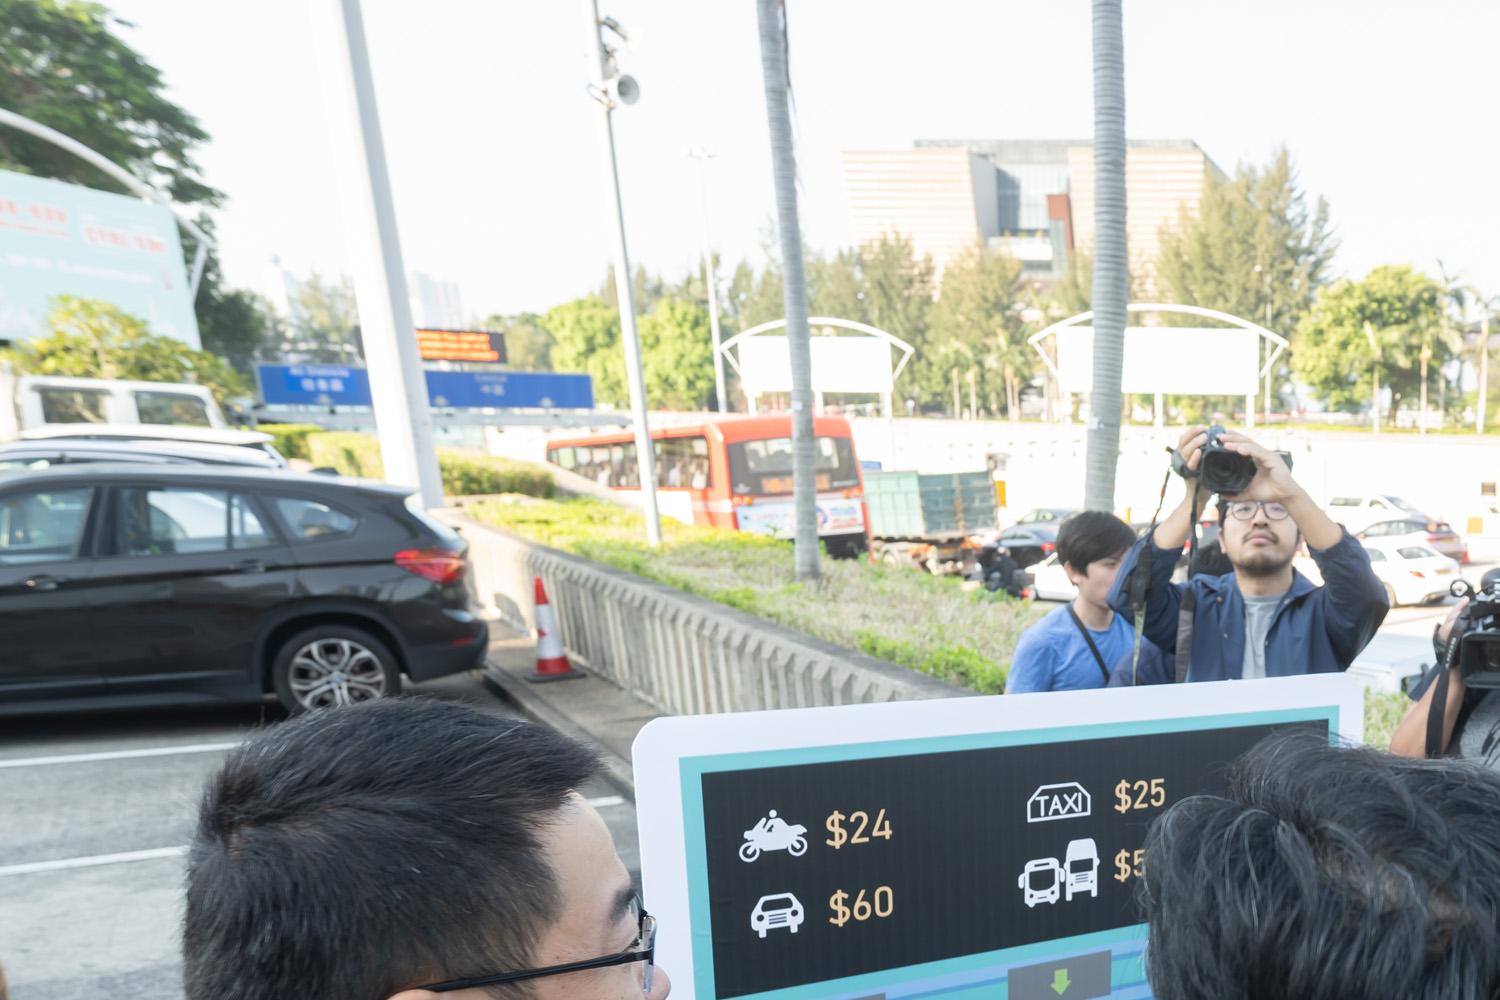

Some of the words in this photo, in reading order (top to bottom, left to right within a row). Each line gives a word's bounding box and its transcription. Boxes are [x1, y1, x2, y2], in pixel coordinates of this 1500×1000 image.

[1035, 791, 1083, 817] TAXI
[1114, 778, 1166, 814] $25
[826, 808, 893, 849] $24
[829, 885, 894, 927] $60
